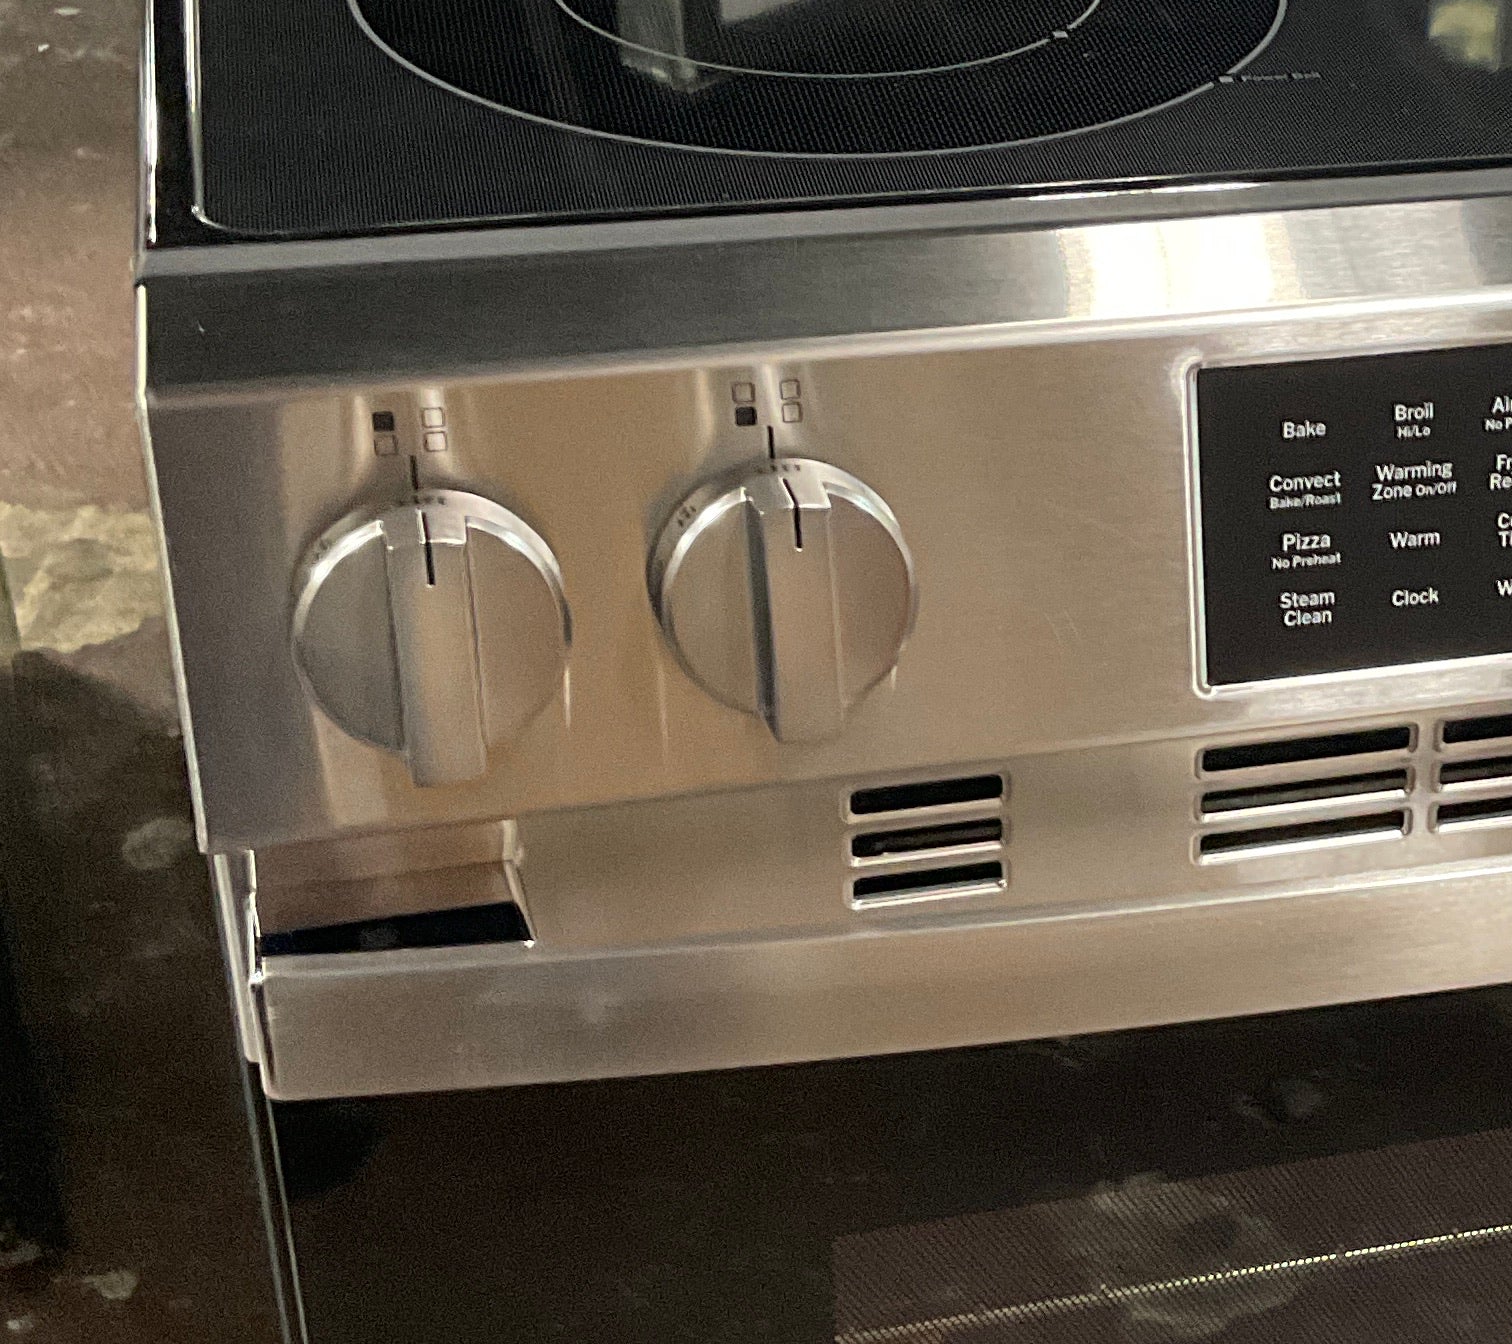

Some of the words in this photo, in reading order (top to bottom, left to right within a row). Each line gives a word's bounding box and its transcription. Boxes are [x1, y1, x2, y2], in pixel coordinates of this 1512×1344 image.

[1394, 401, 1434, 422] Broil
[1282, 419, 1327, 439] Bake
[1396, 424, 1431, 439] Hi/Lo
[1485, 418, 1503, 431] No
[1374, 460, 1453, 482] Warming
[1269, 470, 1342, 493] Convect
[1269, 492, 1342, 510] Bake/Roast
[1371, 483, 1413, 501] Zone
[1282, 532, 1331, 553] Pizza
[1388, 531, 1441, 549] Warm
[1271, 556, 1290, 570] No
[1292, 552, 1342, 569] Preheat
[1279, 591, 1336, 609] Steam
[1391, 586, 1439, 607] Clock
[1283, 609, 1333, 627] Clean
